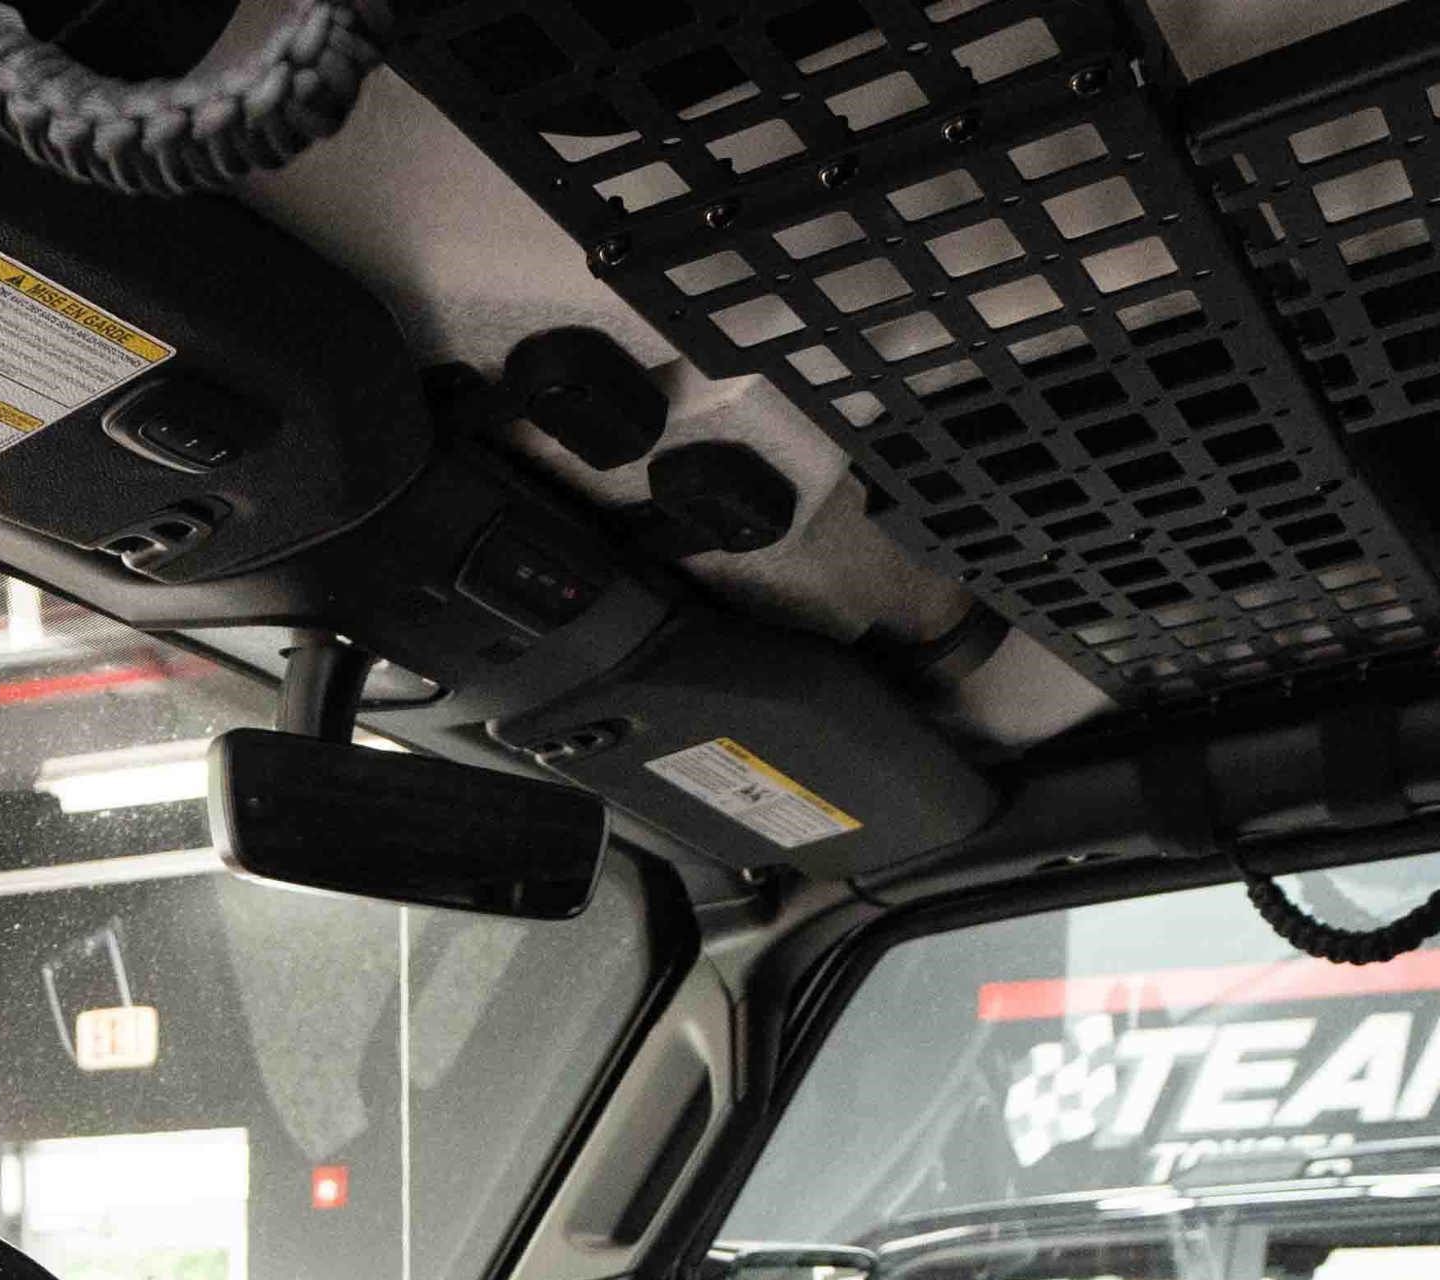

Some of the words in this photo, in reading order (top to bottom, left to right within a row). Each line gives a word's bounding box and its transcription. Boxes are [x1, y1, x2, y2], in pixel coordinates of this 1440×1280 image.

[26, 282, 67, 308] MISE
[62, 303, 87, 320] EN
[83, 313, 134, 343] GARDE
